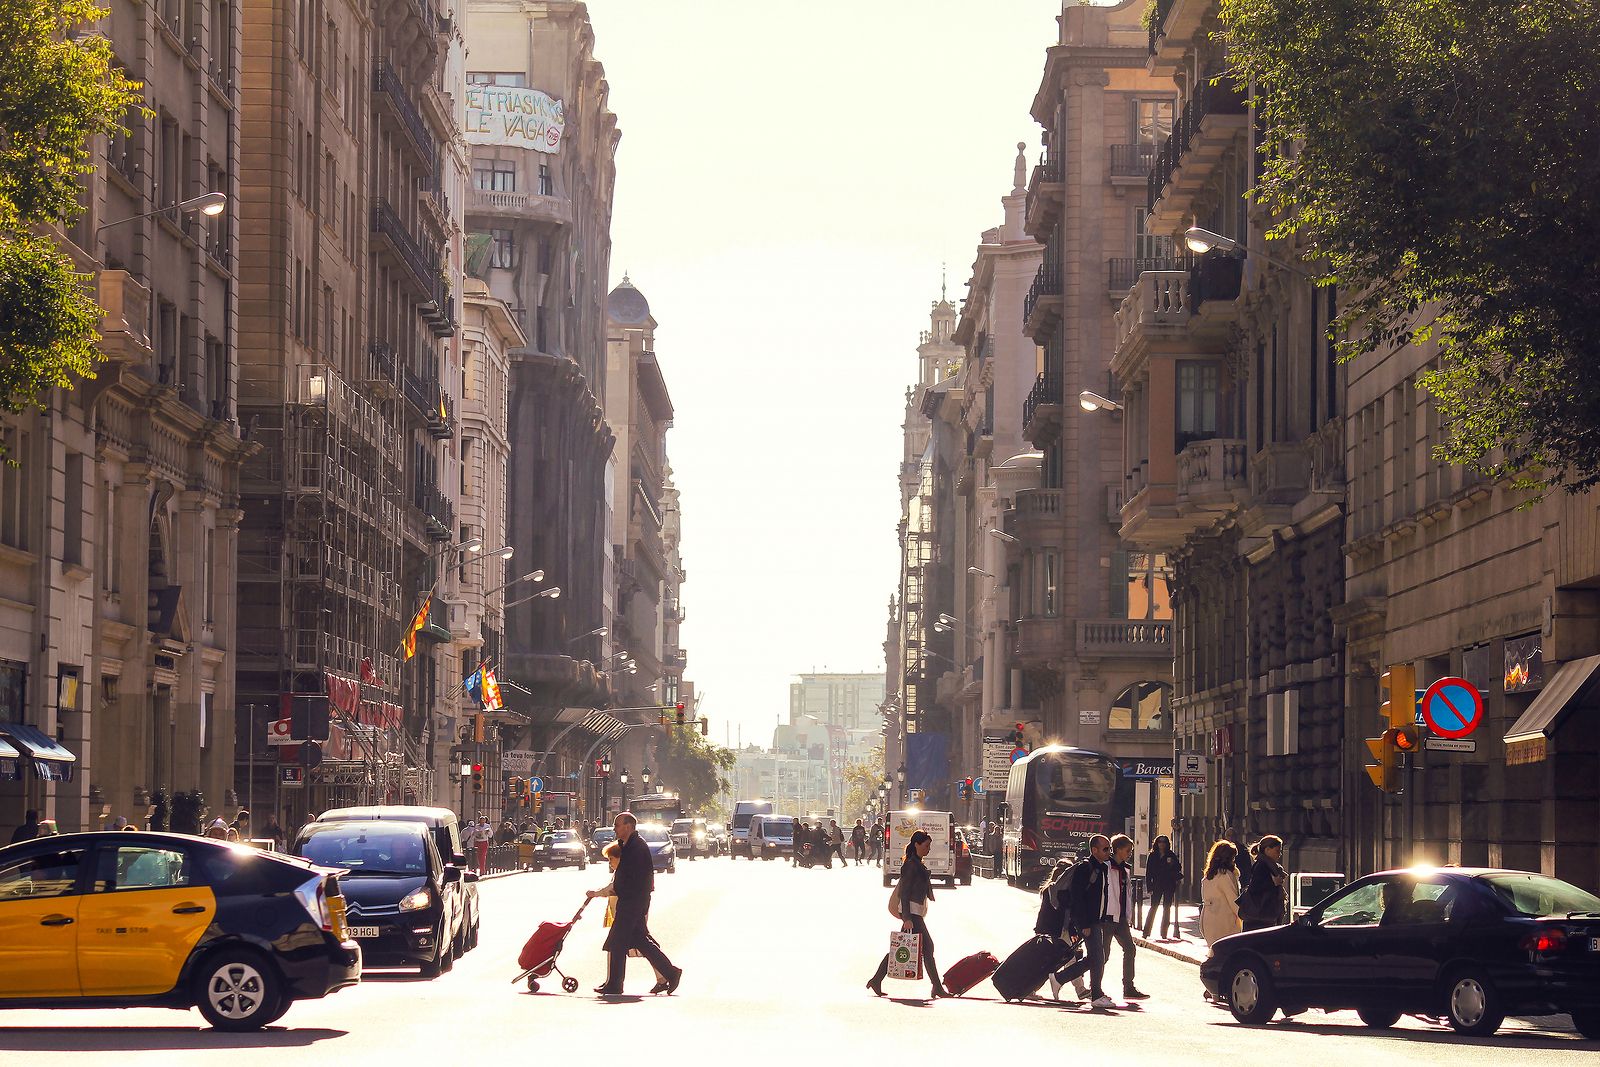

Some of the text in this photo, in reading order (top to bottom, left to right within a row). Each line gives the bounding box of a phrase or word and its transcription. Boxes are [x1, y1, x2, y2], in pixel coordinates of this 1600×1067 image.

[503, 113, 545, 142] VAGA
[1040, 818, 1105, 832] SCHMITT
[360, 928, 377, 936] HGL
